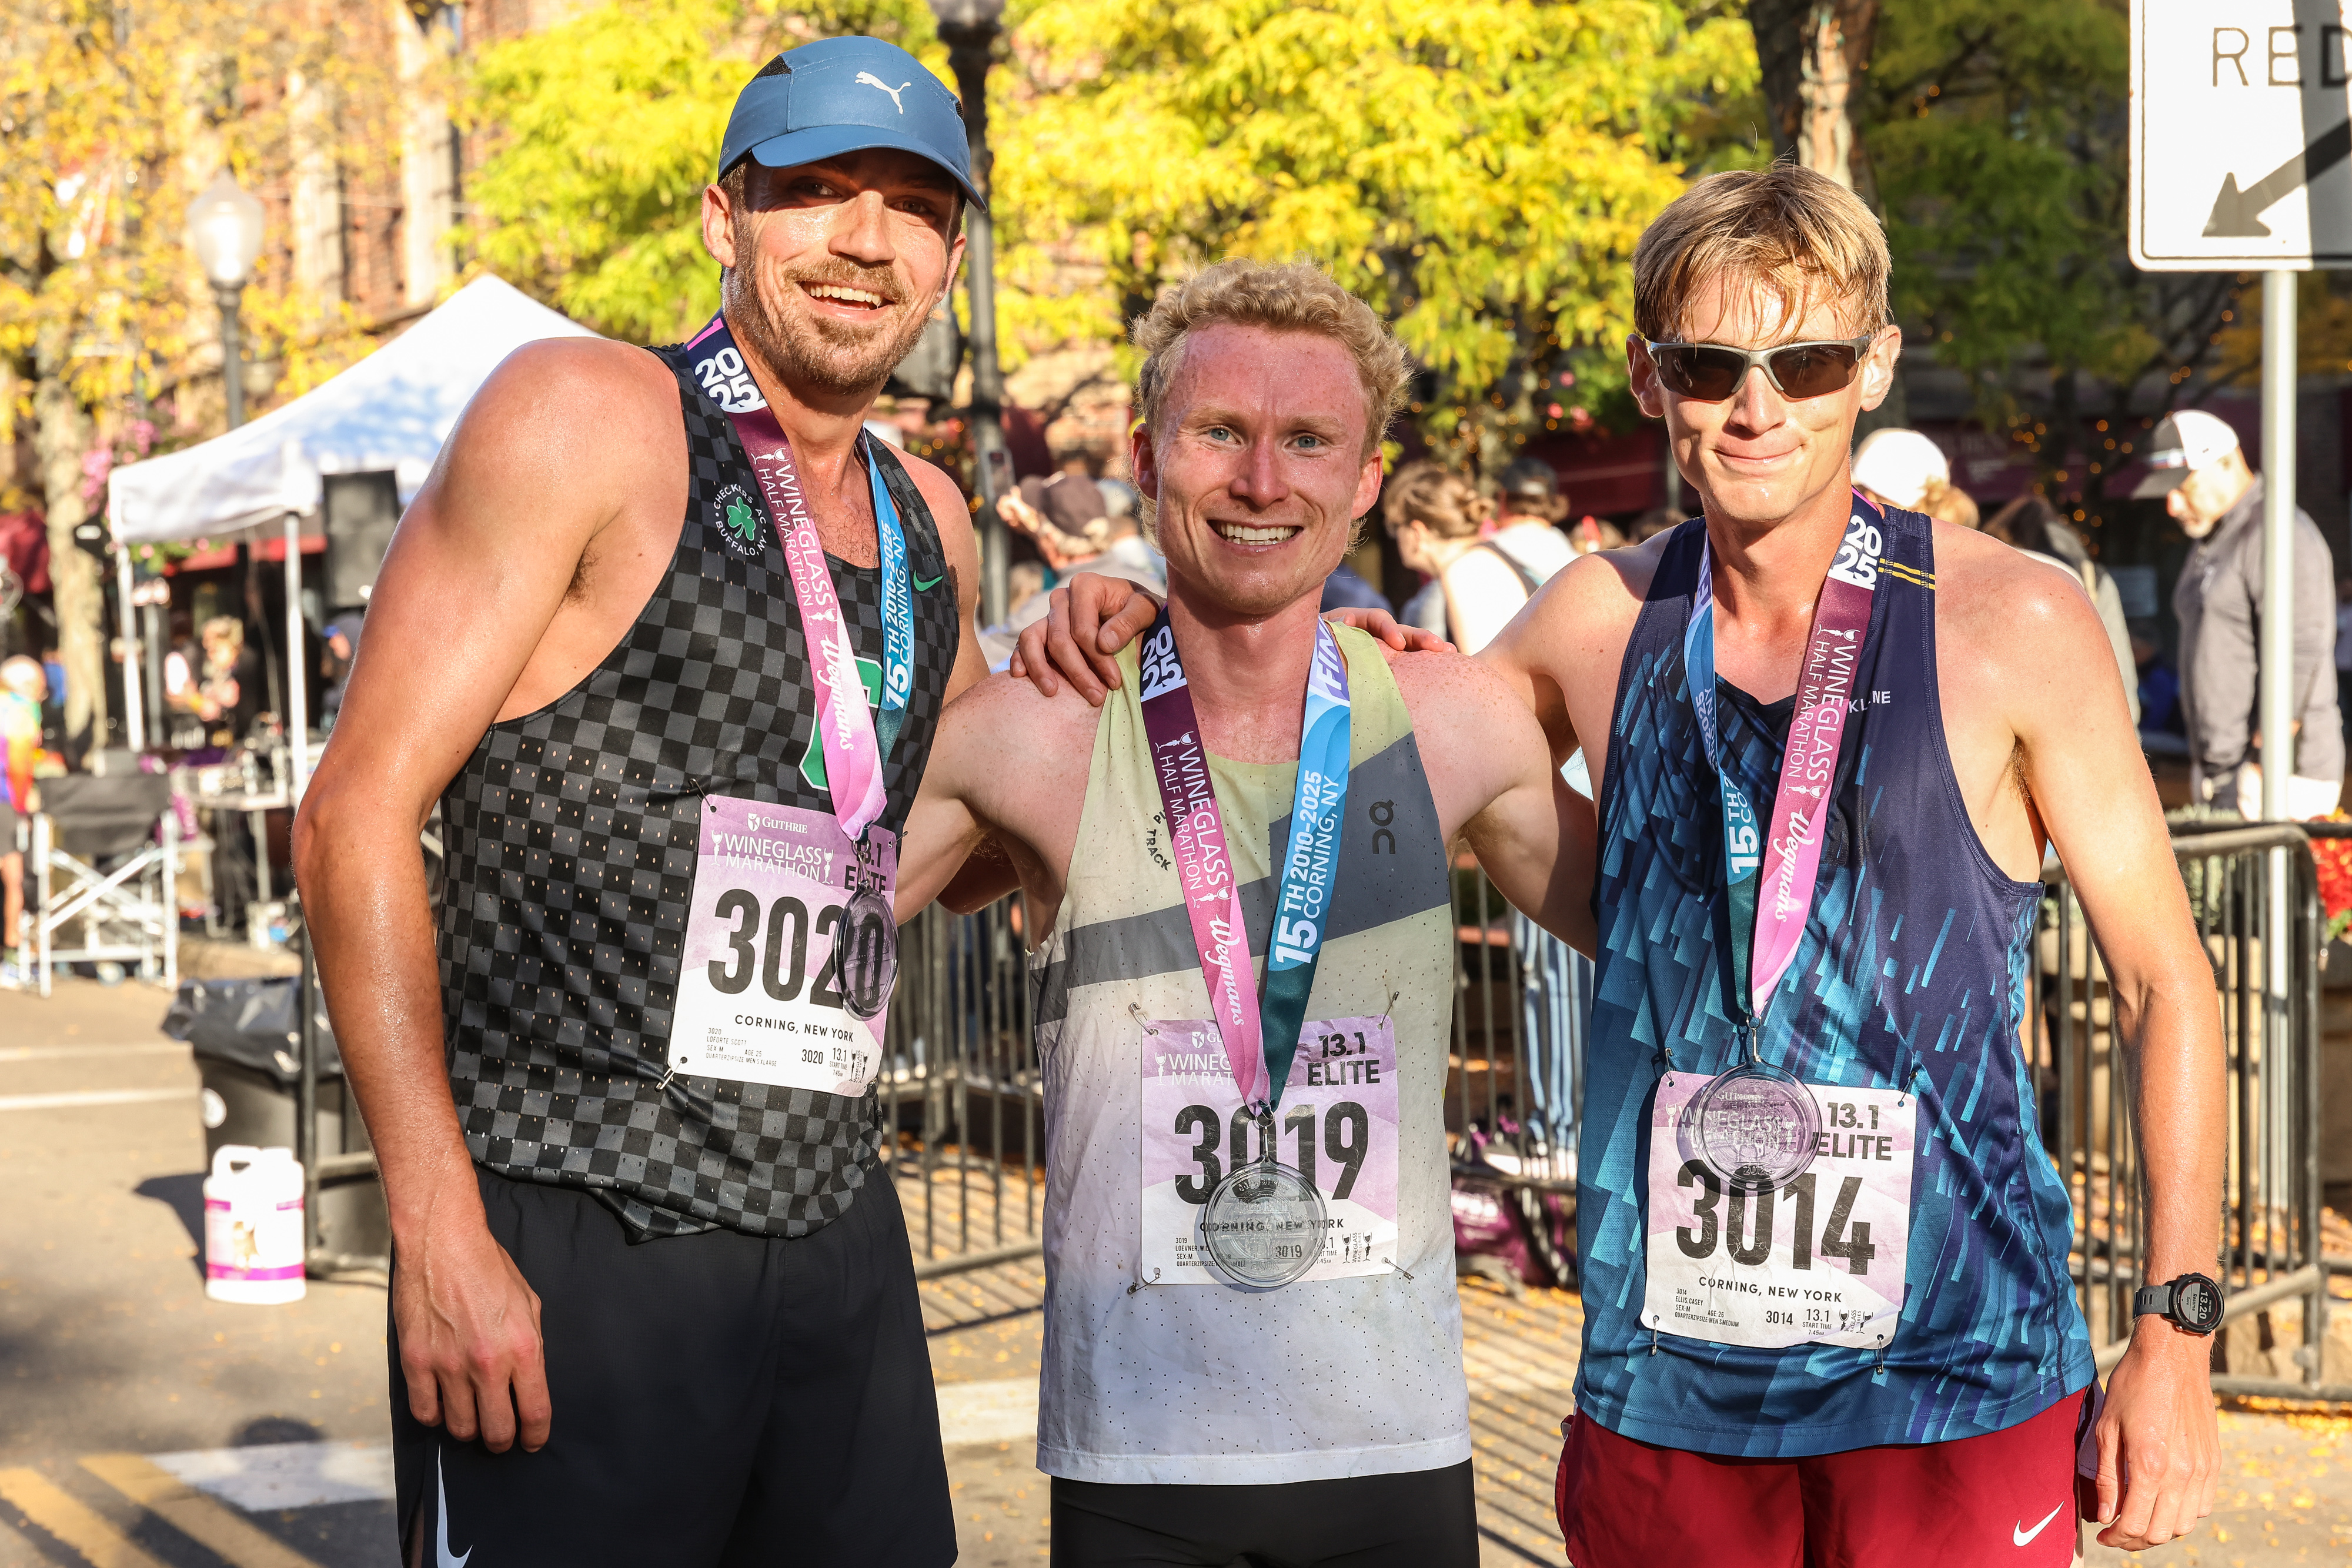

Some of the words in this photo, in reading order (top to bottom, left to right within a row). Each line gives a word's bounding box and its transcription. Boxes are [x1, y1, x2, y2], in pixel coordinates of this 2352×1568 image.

[2213, 24, 2352, 88] RED
[713, 484, 753, 510] CHECKERS
[755, 509, 766, 524] AC
[757, 536, 767, 551] NY
[759, 468, 784, 507] HALF
[776, 513, 813, 606] MARATHON
[775, 464, 833, 606] WINEGLASS
[891, 529, 903, 560] NY
[881, 520, 898, 626] 2010-2025
[1809, 641, 1830, 681] HALF
[817, 634, 854, 751] Wegmans
[1849, 690, 1890, 713] KLNE
[1806, 644, 1857, 782] WINEGLASS
[1787, 685, 1819, 778] MARATHON
[1160, 754, 1182, 798] HALF
[762, 817, 807, 834] GUTHRIE
[1179, 745, 1228, 885] WINEGLASS
[1290, 770, 1322, 881] 2010-2025
[724, 833, 822, 865] WINEGLASS
[1147, 829, 1171, 871] TRACK
[1170, 799, 1203, 890] MARATHON
[1304, 813, 1338, 918] CORNING,
[1322, 775, 1340, 807] NY
[726, 852, 821, 881] MARATHON
[1773, 808, 1815, 923] Wegmans
[708, 888, 884, 1010] 3020
[1205, 914, 1244, 1026] Wegmans
[707, 1036, 729, 1044] LOFORTE
[735, 1015, 799, 1034] CORNING,
[804, 1024, 828, 1037] NEW
[831, 1028, 854, 1042] YORK
[802, 1049, 823, 1064] 3020
[833, 1048, 847, 1062] 13.1
[1318, 1032, 1365, 1058] 13.1
[1169, 1054, 1231, 1071] WINEG
[1307, 1059, 1381, 1086] ELITE
[1171, 1072, 1235, 1086] MARAT
[1827, 1102, 1879, 1129] 13.1
[1175, 1101, 1369, 1205] 3019
[1813, 1132, 1893, 1161] ELITE
[1676, 1159, 1875, 1275] 3014
[1275, 1245, 1302, 1258] 3019
[1699, 1276, 1762, 1296] CORNING,
[1768, 1286, 1798, 1298] NEW
[1803, 1289, 1842, 1302] YORK
[1766, 1310, 1793, 1325] 3014
[1806, 1309, 1829, 1322] 13.1
[2199, 1292, 2209, 1319] 13.20
